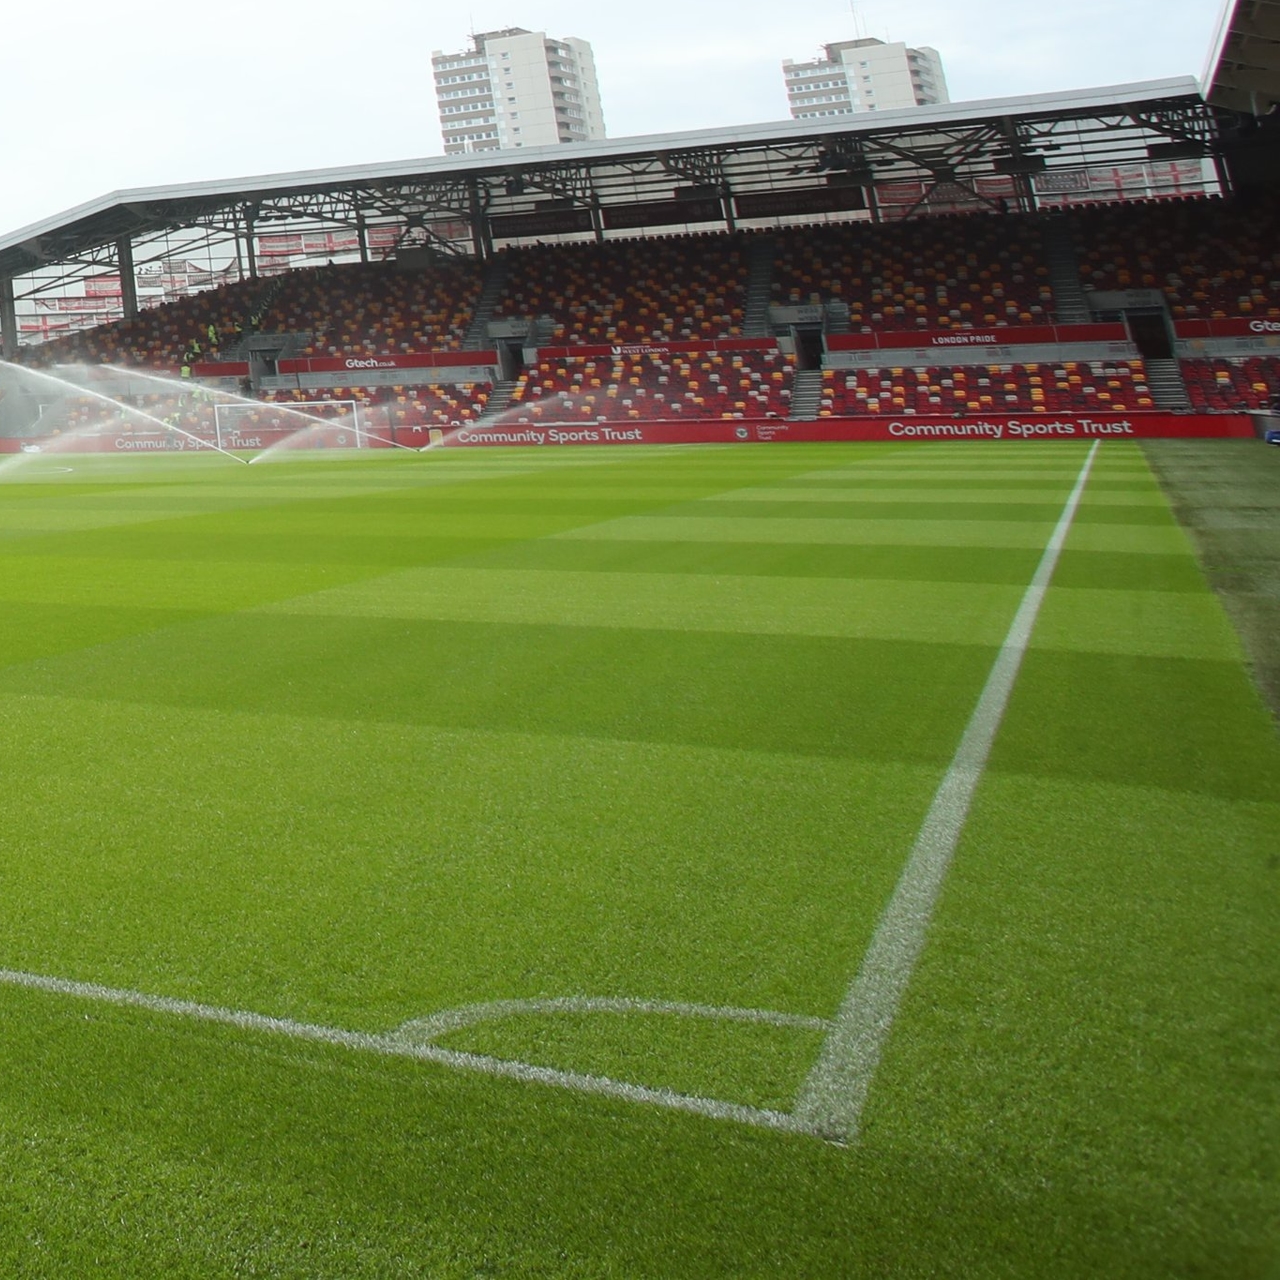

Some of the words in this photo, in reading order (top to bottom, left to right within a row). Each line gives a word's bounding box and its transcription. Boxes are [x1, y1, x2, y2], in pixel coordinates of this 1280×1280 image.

[932, 335, 968, 344] LONDON
[970, 334, 997, 343] PRIDE
[345, 357, 396, 368] Gtech.co.uk
[888, 421, 1003, 438] Community
[1007, 420, 1073, 437] Sports
[1077, 419, 1133, 434] Trust
[231, 436, 262, 447] Trust
[457, 430, 545, 444] Community
[548, 429, 599, 444] Sports
[601, 428, 643, 440] Trust
